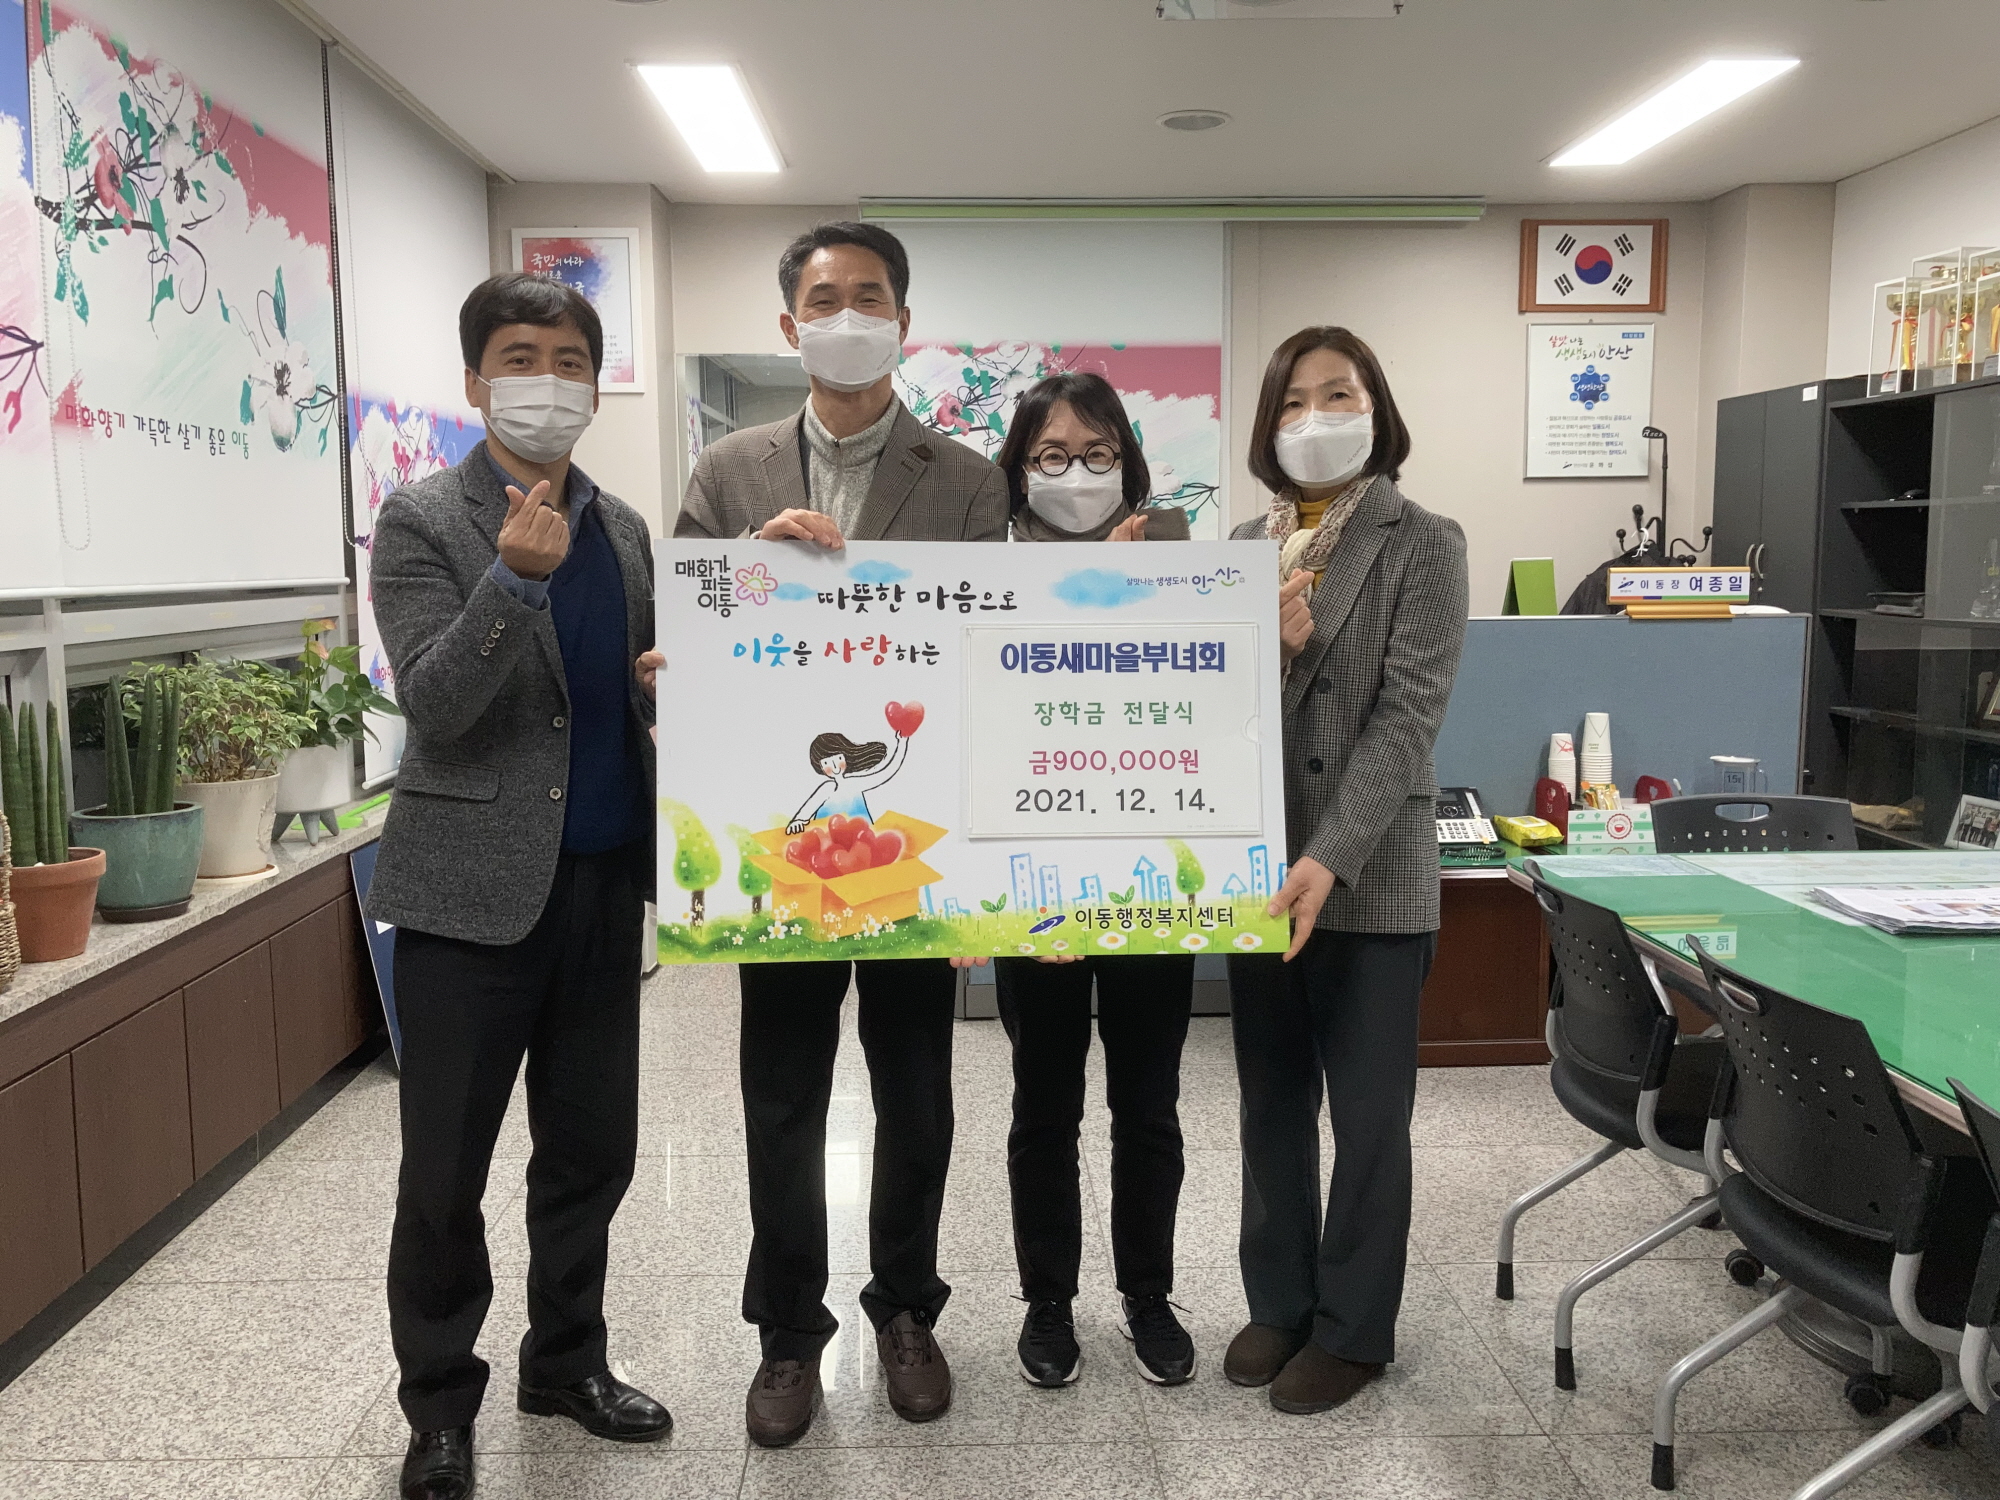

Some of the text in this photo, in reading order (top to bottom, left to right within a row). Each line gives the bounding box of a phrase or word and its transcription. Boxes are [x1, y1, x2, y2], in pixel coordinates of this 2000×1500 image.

[531, 253, 585, 269] 국민의 나라
[1549, 335, 1583, 348] 살맛 나는
[1555, 344, 1633, 361] 생생도시 안산
[133, 415, 171, 446] 가득한
[178, 422, 201, 450] 살기
[208, 427, 226, 456] 좋은
[231, 431, 249, 460] 이동
[674, 554, 731, 578] 매화가
[701, 574, 733, 592] 피는
[1155, 576, 1188, 587] 생생도시
[1689, 575, 1743, 593] 여종일
[697, 592, 739, 618] 이동
[817, 580, 1018, 614] 따뜻한 마음으로
[733, 633, 940, 667] 이웃을 사랑하는
[1000, 642, 1226, 674] 이동새마을부녀회
[1034, 701, 1193, 727] 장학금 전달식
[1028, 749, 1200, 776] 금900,000원
[1015, 788, 1216, 815] 2021. 12. 14.
[1075, 905, 1235, 930] 이동행정복지센터
